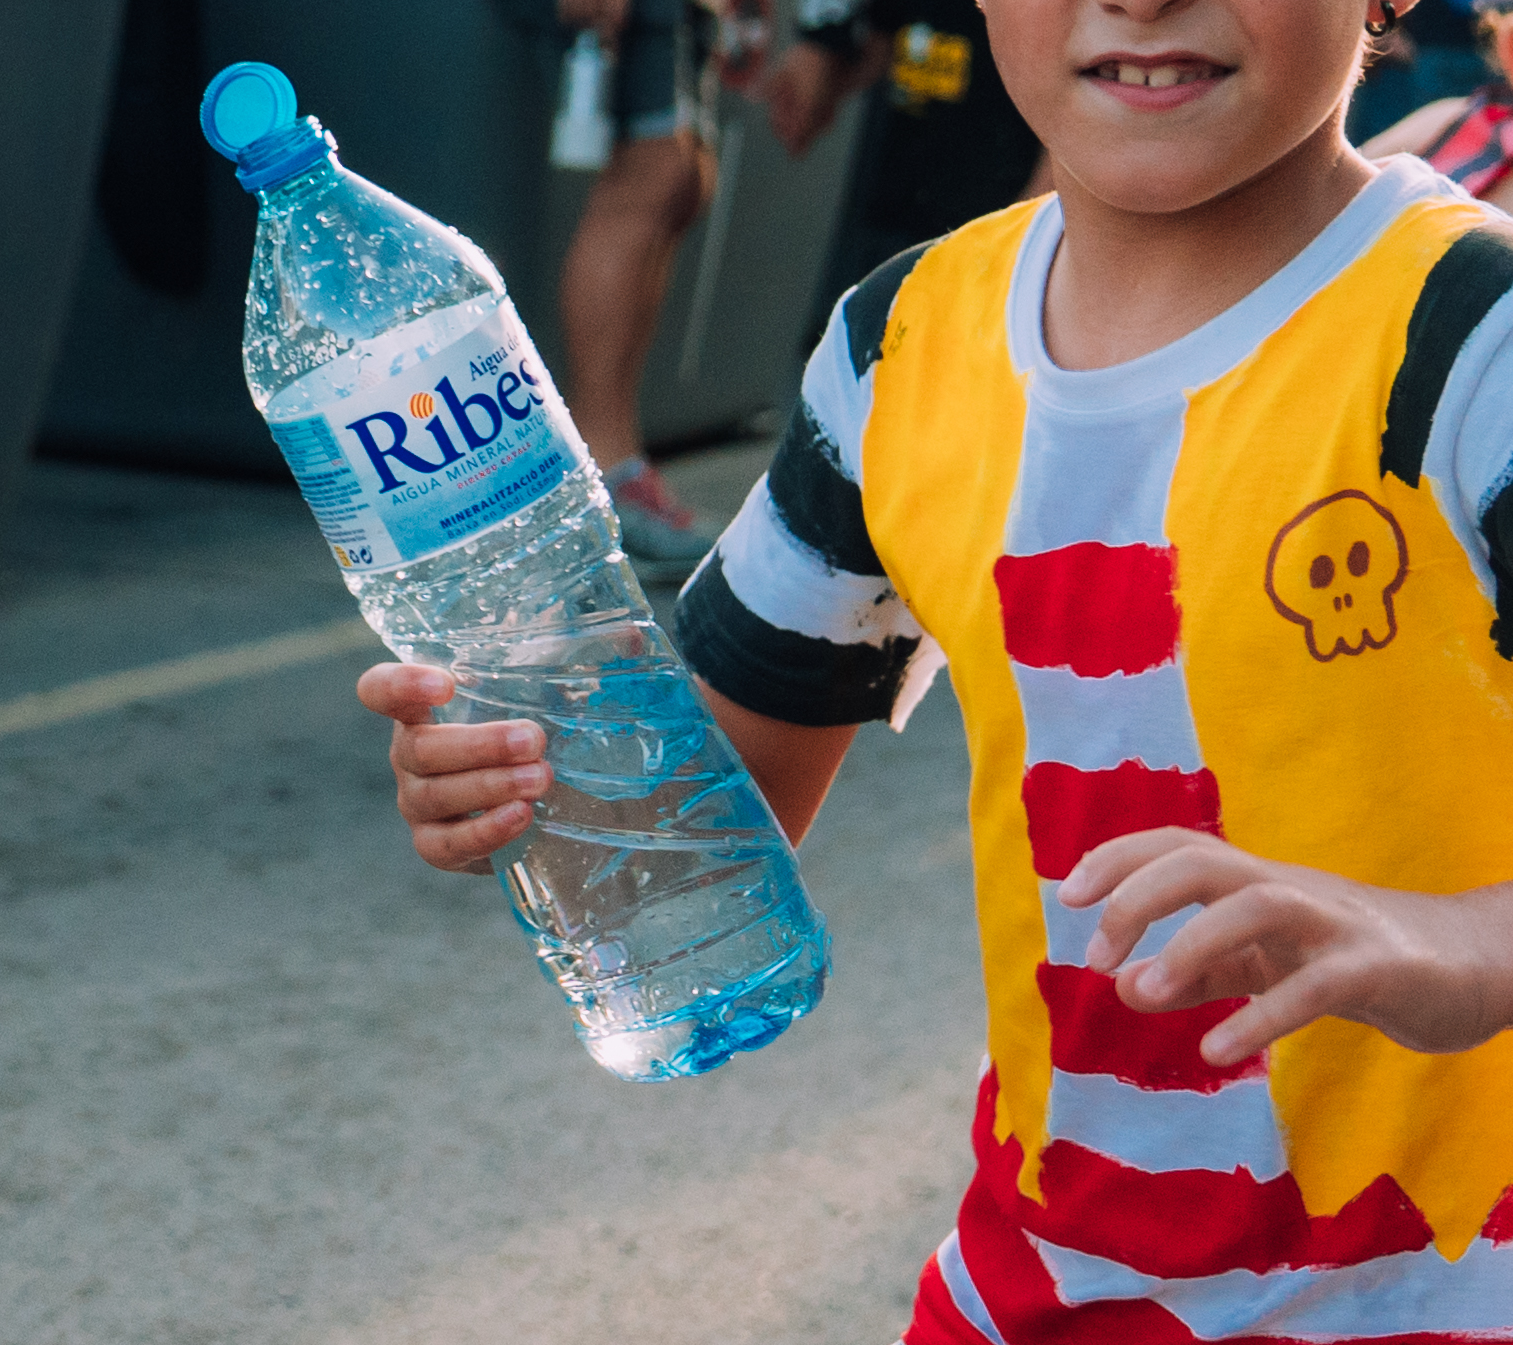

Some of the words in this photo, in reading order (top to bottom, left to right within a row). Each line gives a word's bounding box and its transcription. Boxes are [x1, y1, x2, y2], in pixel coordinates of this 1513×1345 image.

[469, 347, 509, 382] Aigua
[391, 477, 442, 506] AIGUA
[445, 437, 515, 482] MINERAL
[514, 408, 548, 441] NATUR
[439, 469, 538, 530] MINERALITZACIÓ
[482, 509, 497, 523] en
